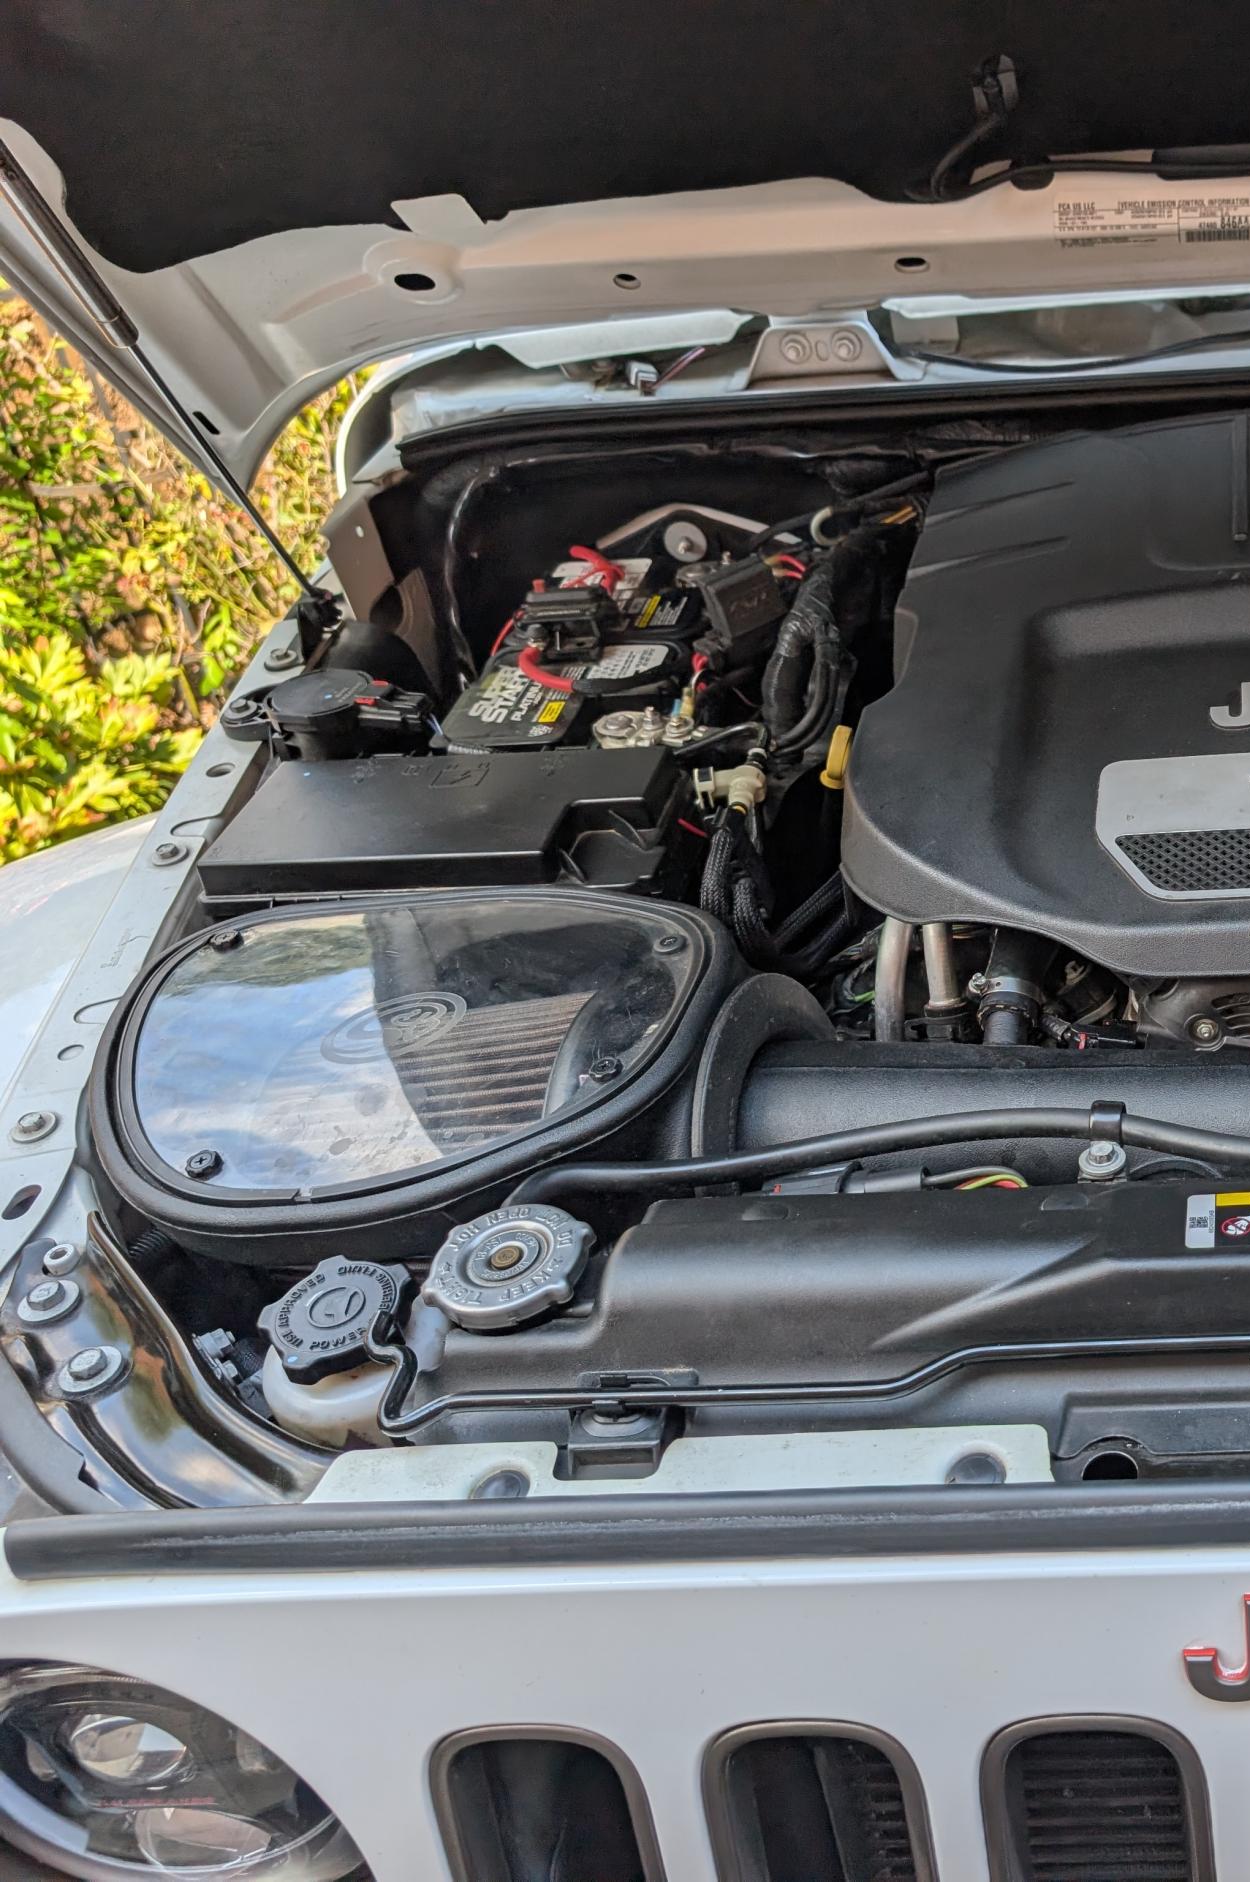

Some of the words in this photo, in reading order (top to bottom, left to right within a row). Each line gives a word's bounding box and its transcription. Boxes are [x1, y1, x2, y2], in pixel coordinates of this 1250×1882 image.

[1083, 202, 1095, 210] LLC
[1120, 200, 1145, 209] VEHICLE
[1146, 199, 1177, 209] EMISSION
[1178, 199, 1205, 208] CONTROL
[1207, 197, 1249, 206] INFORMATION
[481, 668, 528, 723] STAR
[510, 682, 543, 721] PLATINU
[486, 1207, 532, 1226] OPEN
[535, 1213, 570, 1231] NOT
[448, 1223, 481, 1252] HOT
[556, 1229, 573, 1249] DO
[337, 1265, 379, 1277] FLUID
[435, 1274, 484, 1305] TIGHT
[500, 1271, 552, 1302] KEEP
[309, 1326, 368, 1350] POWER
